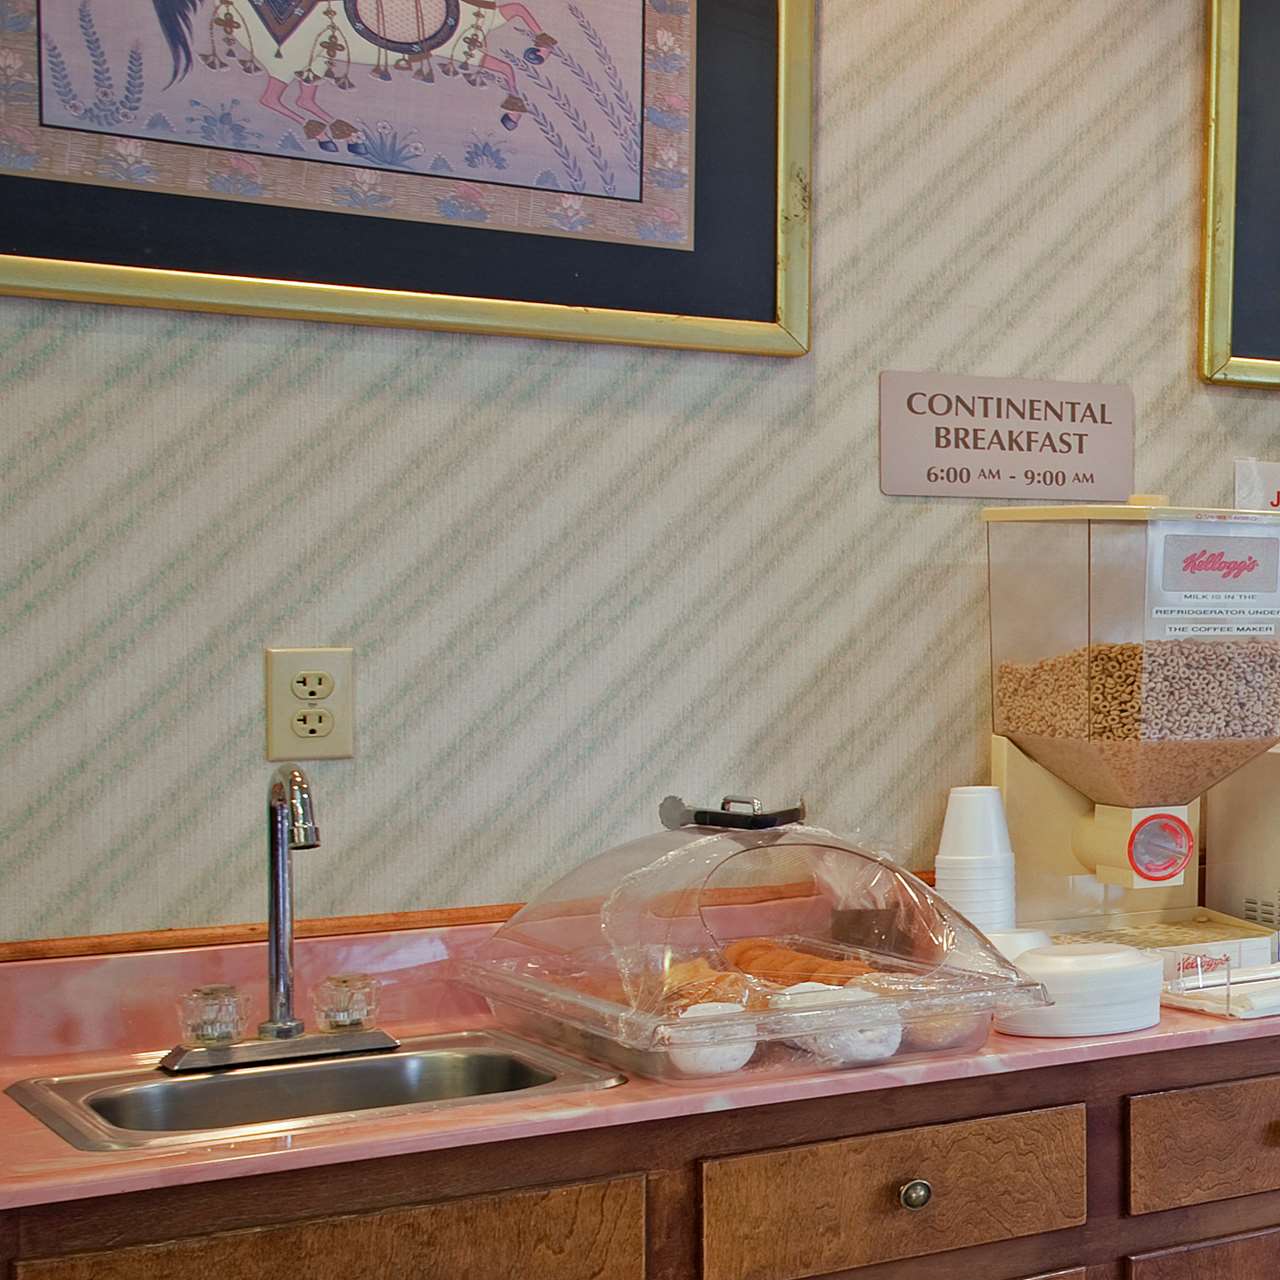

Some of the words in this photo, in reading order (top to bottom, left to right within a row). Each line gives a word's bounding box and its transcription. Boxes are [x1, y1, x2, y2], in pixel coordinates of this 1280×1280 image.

[906, 391, 1113, 426] CONTINENTAL
[934, 426, 1089, 455] BREAKFAST
[926, 465, 971, 484] 6:00
[977, 468, 1002, 481] AM
[1023, 468, 1067, 487] 9:00
[1071, 471, 1095, 485] AM
[1182, 549, 1260, 579] Kellogg's
[1191, 625, 1234, 633] COFFEE
[1176, 953, 1232, 974] Kelogg's
